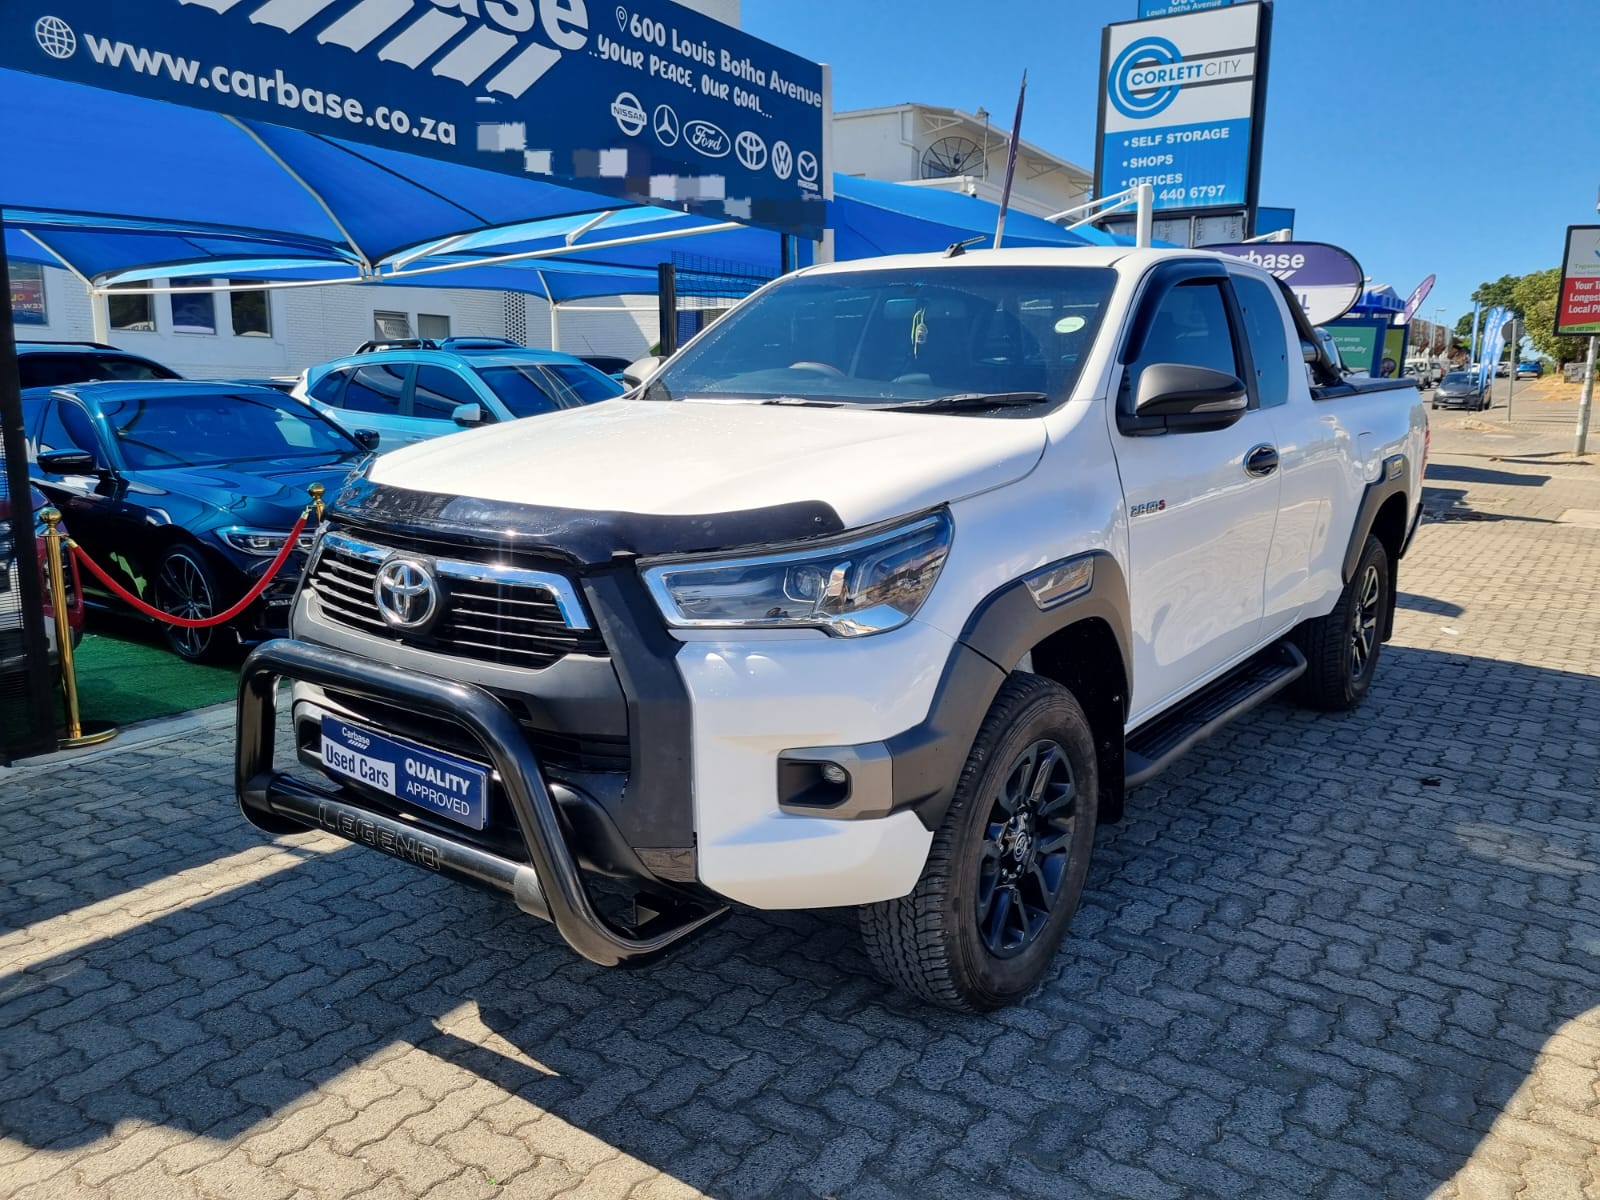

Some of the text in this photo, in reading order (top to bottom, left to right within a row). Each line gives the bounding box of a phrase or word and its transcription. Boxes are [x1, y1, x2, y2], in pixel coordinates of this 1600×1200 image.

[1147, 7, 1166, 16] Louis
[630, 13, 822, 108] 600 Louis Botha Avenue
[650, 54, 697, 93] PEACE,
[701, 74, 730, 101] OUR
[84, 33, 457, 145] www.carbase.co.za
[613, 106, 646, 123] NISSAN
[692, 125, 722, 151] Ford
[1131, 128, 1230, 147] SELF STORAGE
[1130, 155, 1173, 168] SHOPS
[1129, 173, 1183, 188] OFFICES
[1160, 188, 1185, 201] 440
[1190, 184, 1226, 198] 6797
[1575, 281, 1594, 290] Your
[1568, 304, 1591, 314] Local
[342, 727, 371, 746] Carbase
[326, 744, 389, 788] Used Cars
[405, 758, 471, 796] QUALITY
[406, 781, 470, 816] APPROVED
[318, 803, 441, 871] LEGEND
